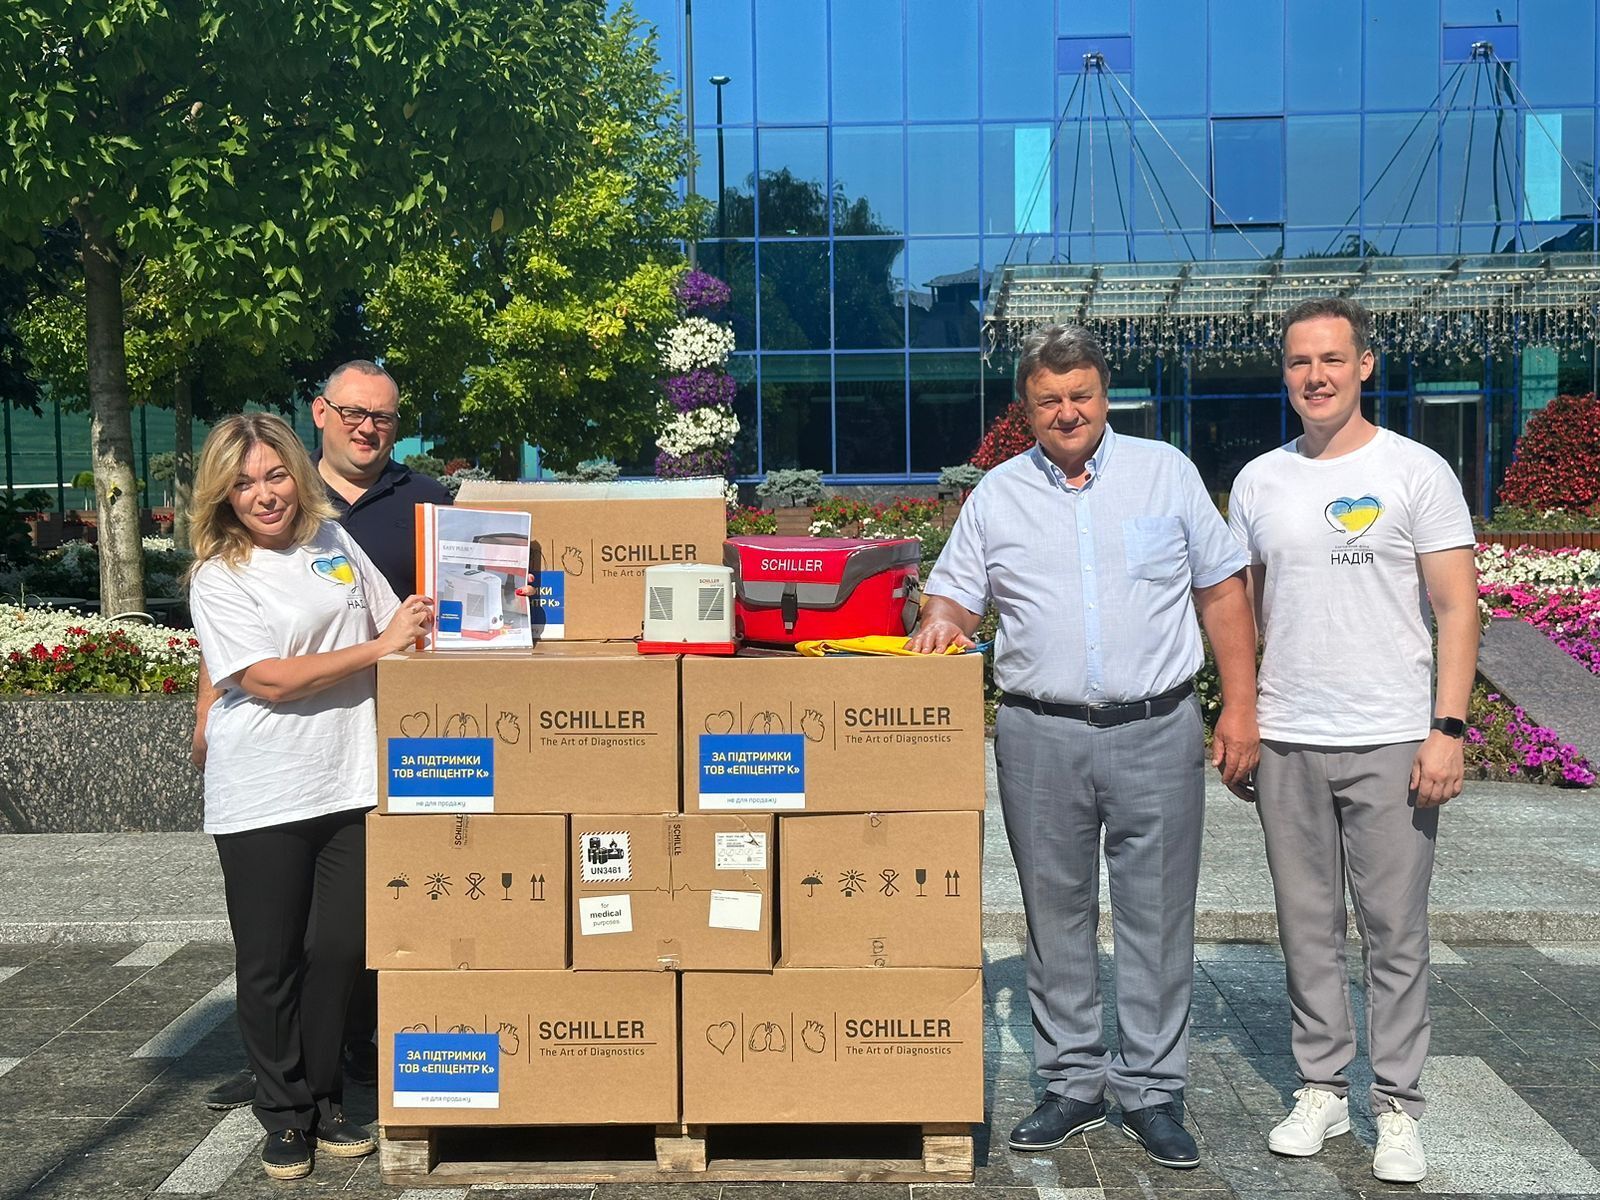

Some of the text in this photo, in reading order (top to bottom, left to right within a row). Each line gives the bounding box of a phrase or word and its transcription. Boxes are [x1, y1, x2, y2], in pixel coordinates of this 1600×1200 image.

[601, 544, 697, 562] SCHILLER
[1331, 552, 1374, 566] НАДІЯ
[761, 558, 823, 572] SCHILLER
[601, 569, 646, 577] The Art of
[540, 710, 645, 730] SCHILLER
[844, 707, 951, 727] SCHILLER
[541, 736, 646, 748] The Art of Diagnostics
[845, 734, 951, 745] The Art of Diagnostics
[401, 755, 481, 768] ЗА ПІДТРИМКИ
[711, 752, 792, 764] ЗА ПІДТРИМКИ
[393, 768, 489, 780] ТОВ «ЕПІЦЕНТР К»
[703, 765, 800, 777] ТОВ «ЕПІЦЕНТР К»
[590, 866, 622, 875] UN3481
[590, 909, 622, 918] medical
[592, 919, 620, 927] purposes
[539, 1021, 645, 1040] SCHILLER
[845, 1019, 951, 1038] SCHILLER
[407, 1051, 486, 1063] ЗА ПІДТРИМКИ
[540, 1047, 645, 1058] The Art of Diagnostics
[846, 1046, 952, 1056] The Art of Diagnostics
[399, 1064, 495, 1076] ТОВ «ЕПІЦЕНТР К»
